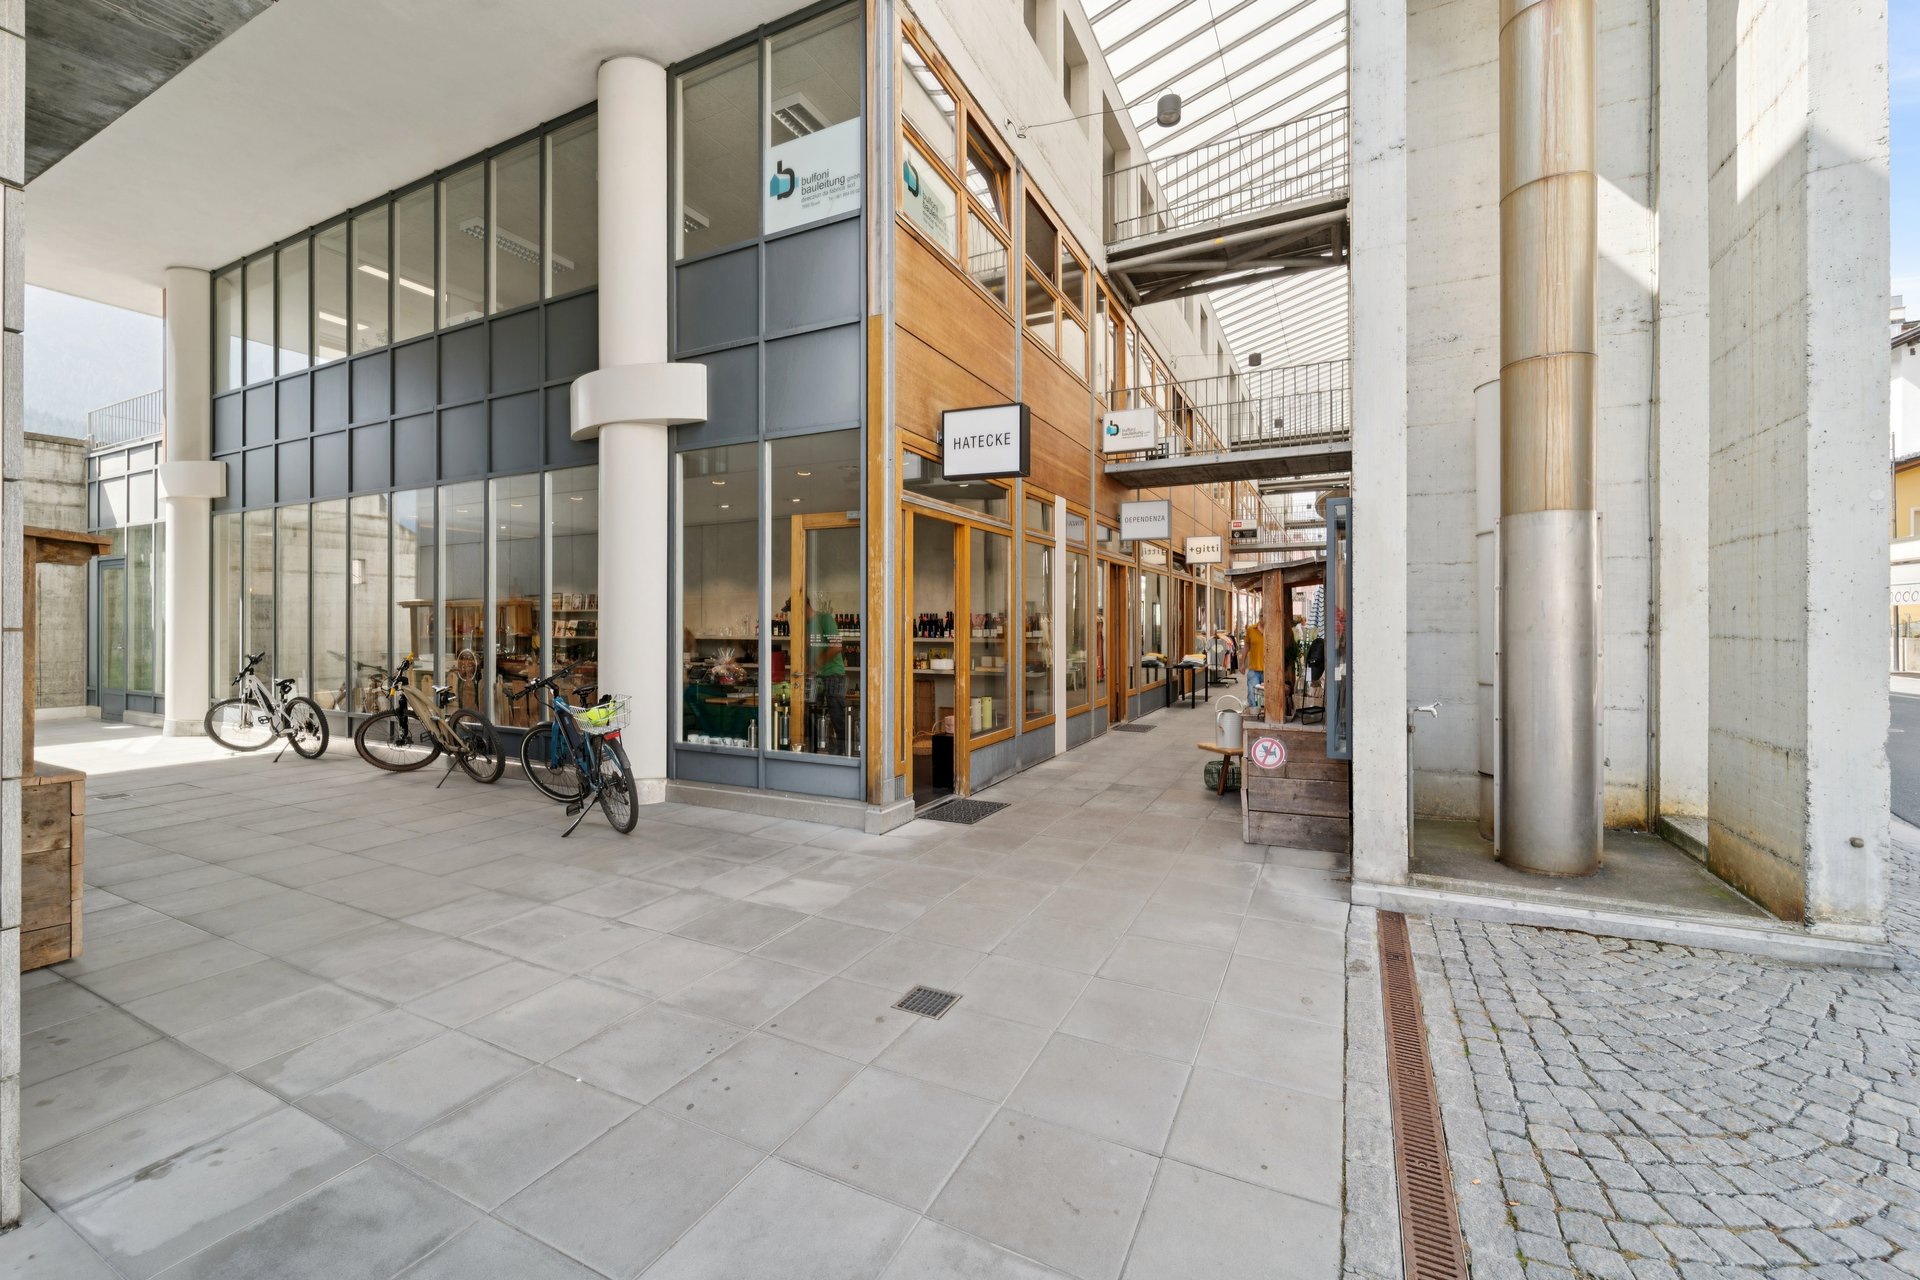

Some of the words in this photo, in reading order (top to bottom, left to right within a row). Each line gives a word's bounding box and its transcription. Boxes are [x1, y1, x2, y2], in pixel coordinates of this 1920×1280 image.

[801, 168, 830, 186] bulfoni
[801, 175, 846, 196] bauleitung
[953, 432, 1011, 450] HATECKE
[1124, 515, 1166, 524] DEPENDENZA
